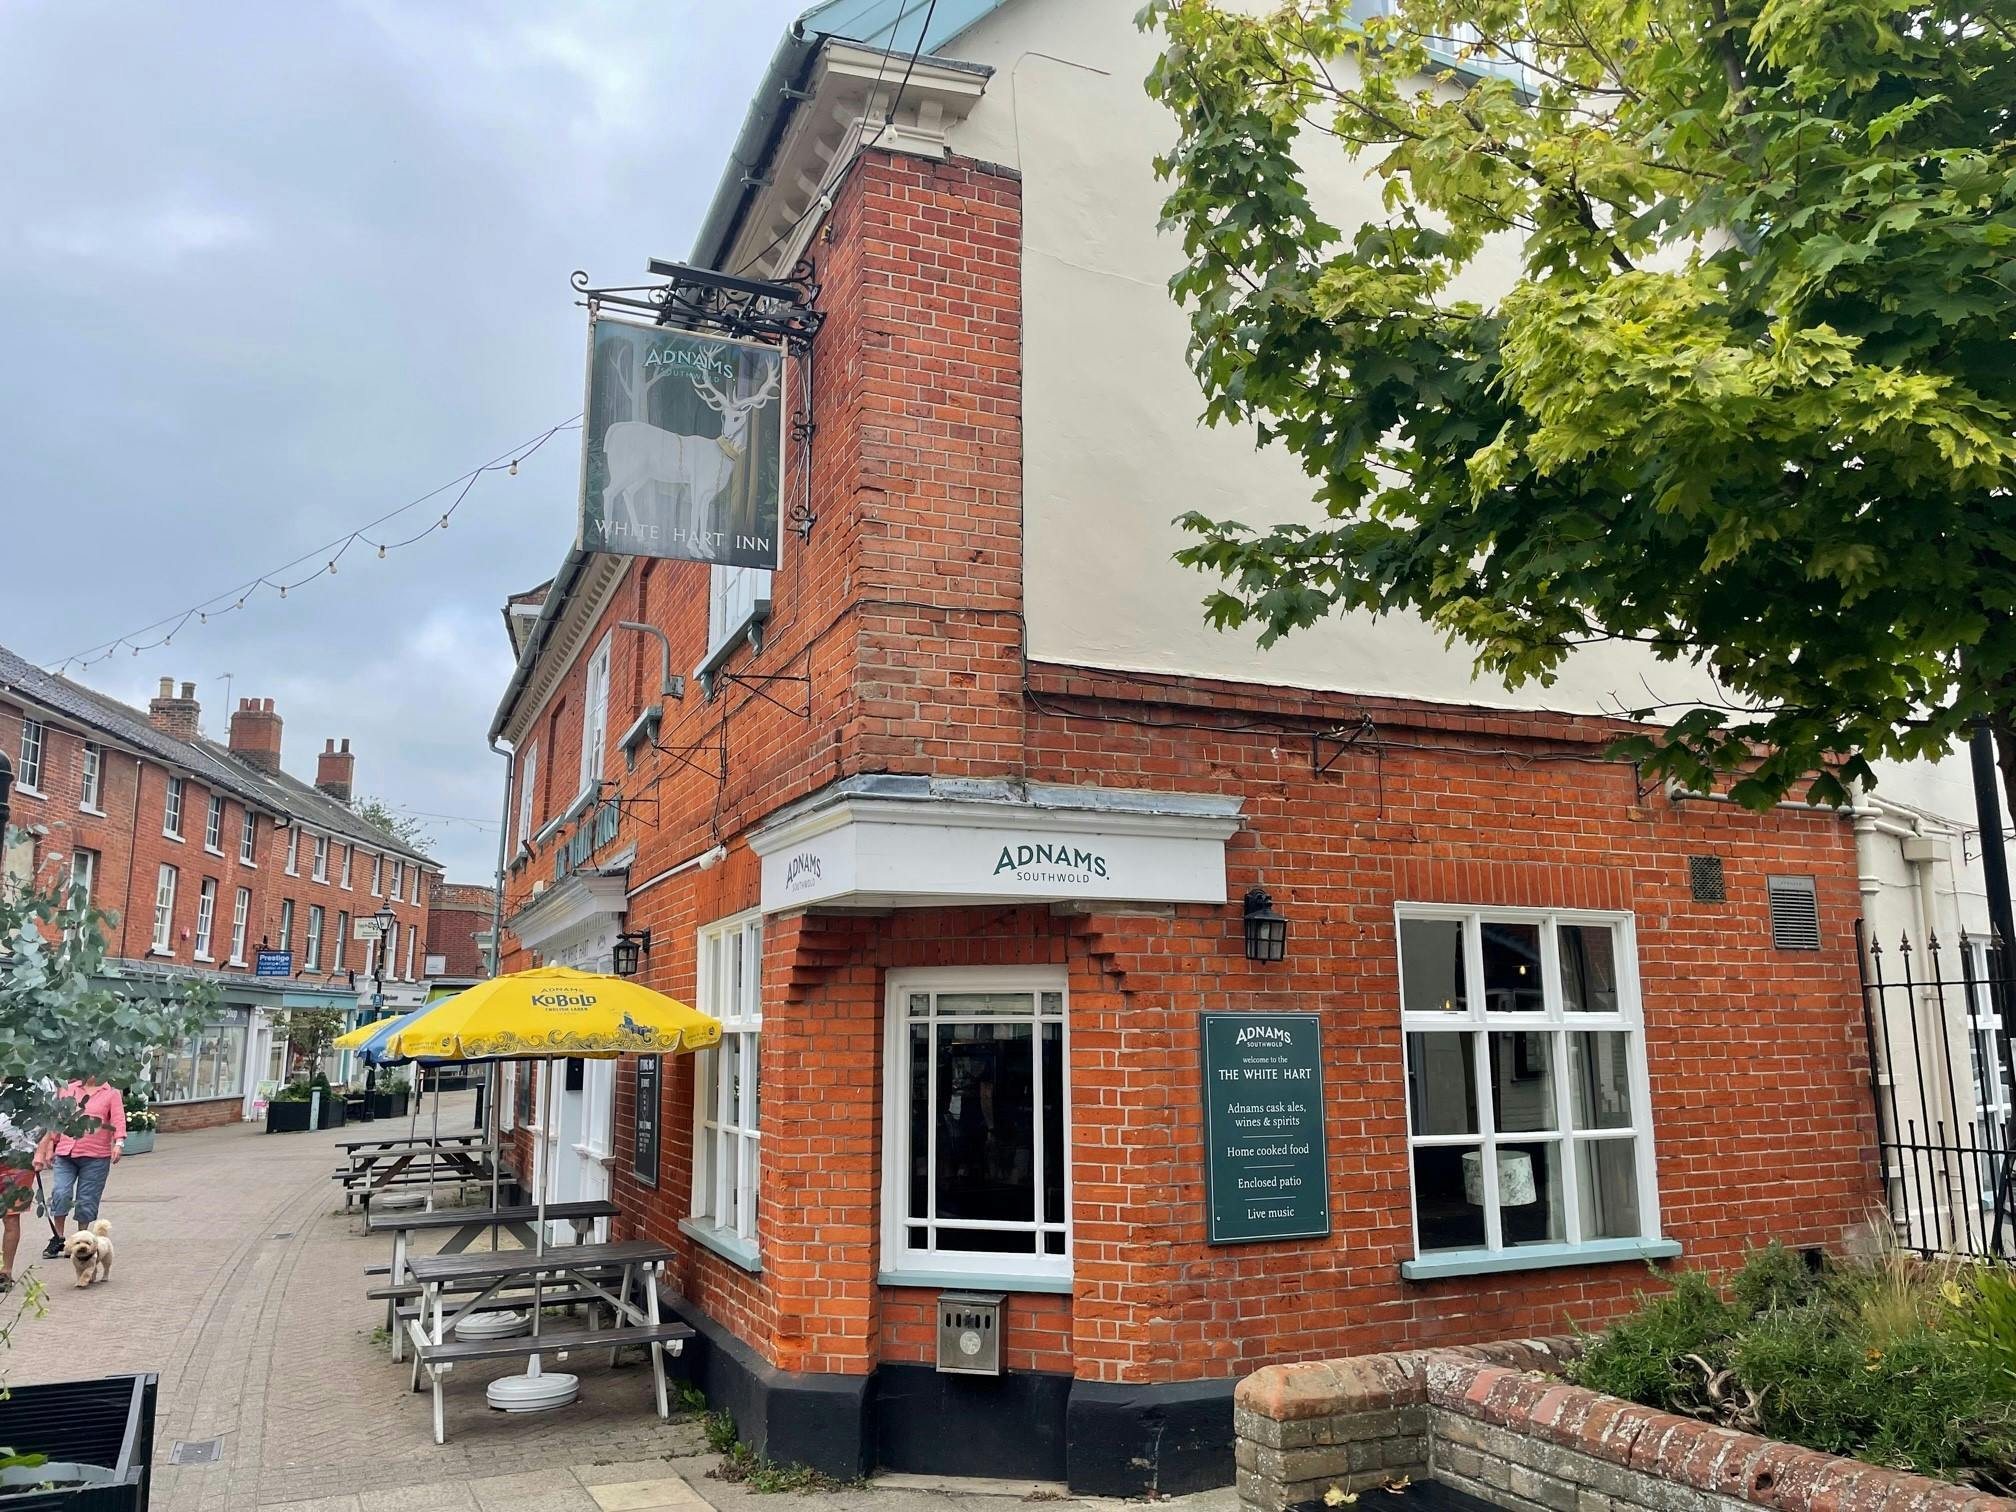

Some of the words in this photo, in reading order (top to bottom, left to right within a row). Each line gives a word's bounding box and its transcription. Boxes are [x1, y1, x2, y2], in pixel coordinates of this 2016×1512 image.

[594, 518, 660, 540] WHITE
[673, 527, 725, 548] HART
[736, 535, 770, 552] INN
[1017, 871, 1090, 883] SOUTHWOLD
[259, 954, 290, 963] Prestige
[1278, 1055, 1288, 1063] the
[1218, 1069, 1239, 1080] THE
[1243, 1068, 1278, 1080] WHITE
[1283, 1068, 1312, 1080] HART
[1227, 1102, 1265, 1114] Adnams
[1266, 1101, 1285, 1112] cask
[1287, 1101, 1307, 1112] ales,
[1235, 1116, 1261, 1127] wines
[1263, 1117, 1271, 1126] &
[1272, 1115, 1300, 1129] spirits
[1227, 1146, 1255, 1157] Home
[1256, 1144, 1287, 1156] cooked
[1289, 1142, 1309, 1154] food
[1238, 1175, 1277, 1189] Enclosed
[1279, 1175, 1302, 1189] patio
[1247, 1208, 1266, 1219] Live
[1268, 1206, 1295, 1218] music
